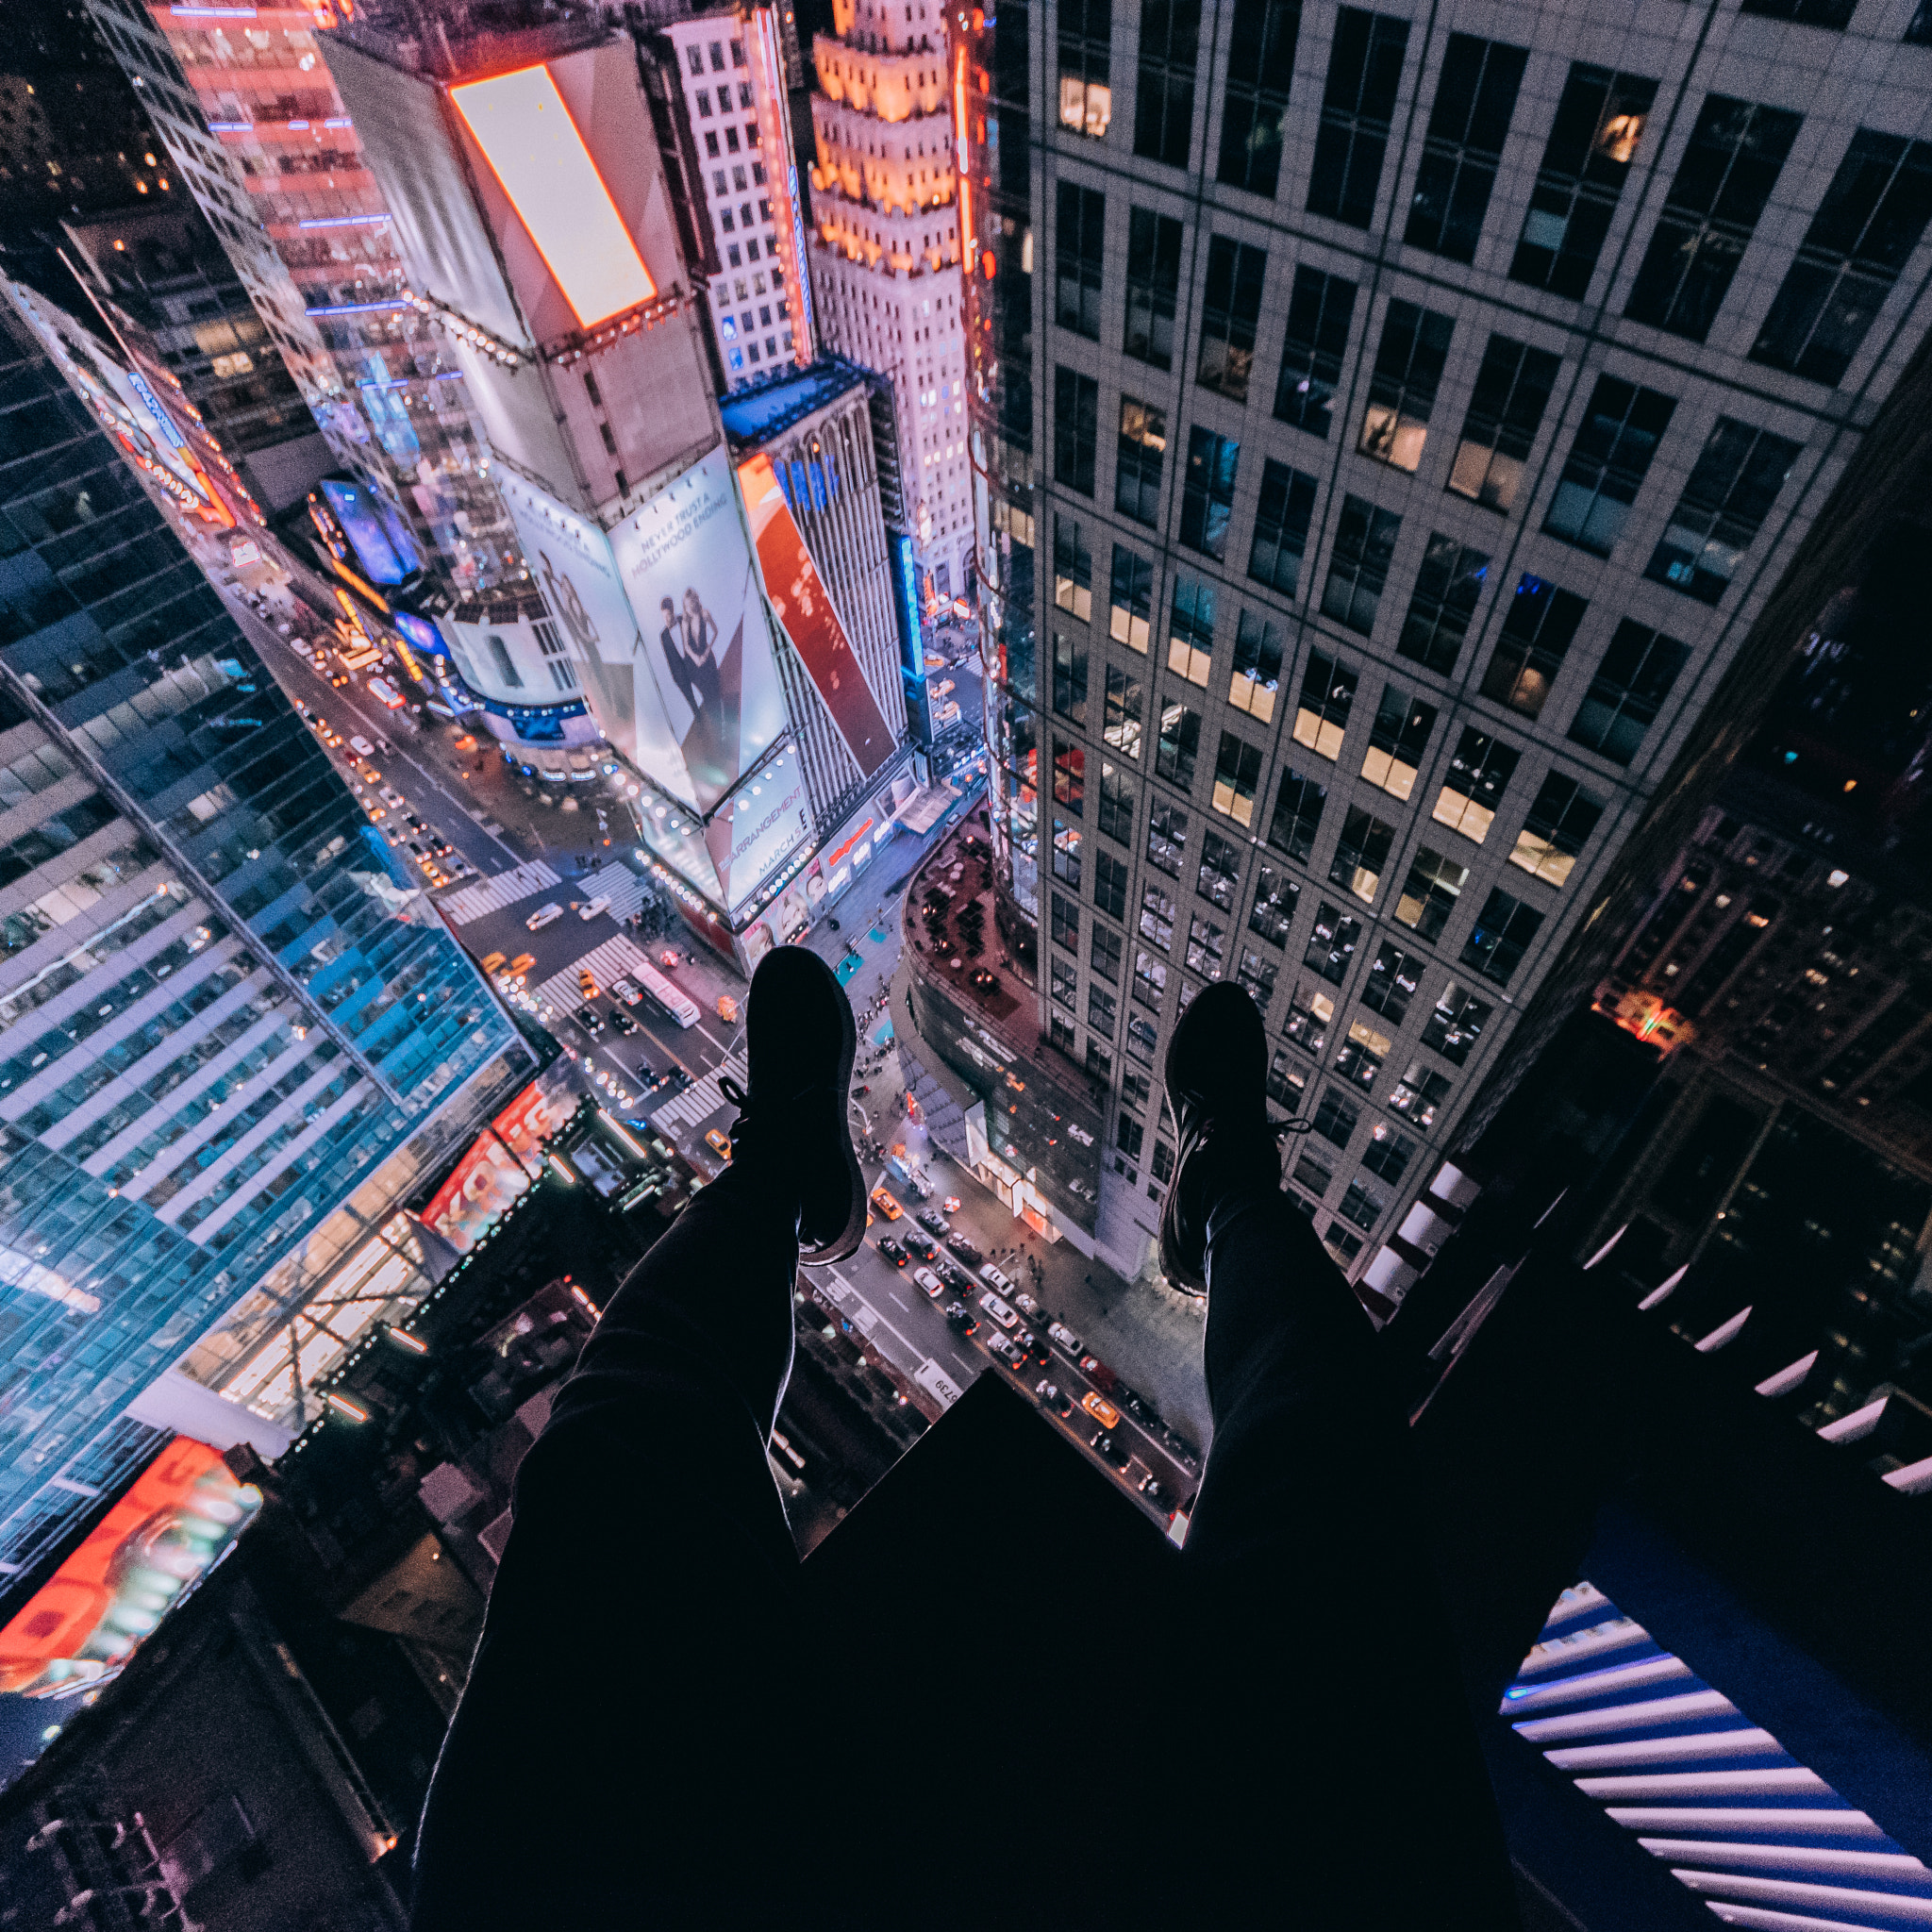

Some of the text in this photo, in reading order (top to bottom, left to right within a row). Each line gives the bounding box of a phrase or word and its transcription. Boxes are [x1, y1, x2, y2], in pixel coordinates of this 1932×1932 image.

[631, 523, 692, 579] HOLLYWOOD
[692, 492, 727, 529] ENDING
[641, 521, 674, 554] NEVER
[675, 496, 702, 525] TRUST
[730, 785, 802, 864] ARRANGEMENT
[758, 833, 794, 876] MARCH
